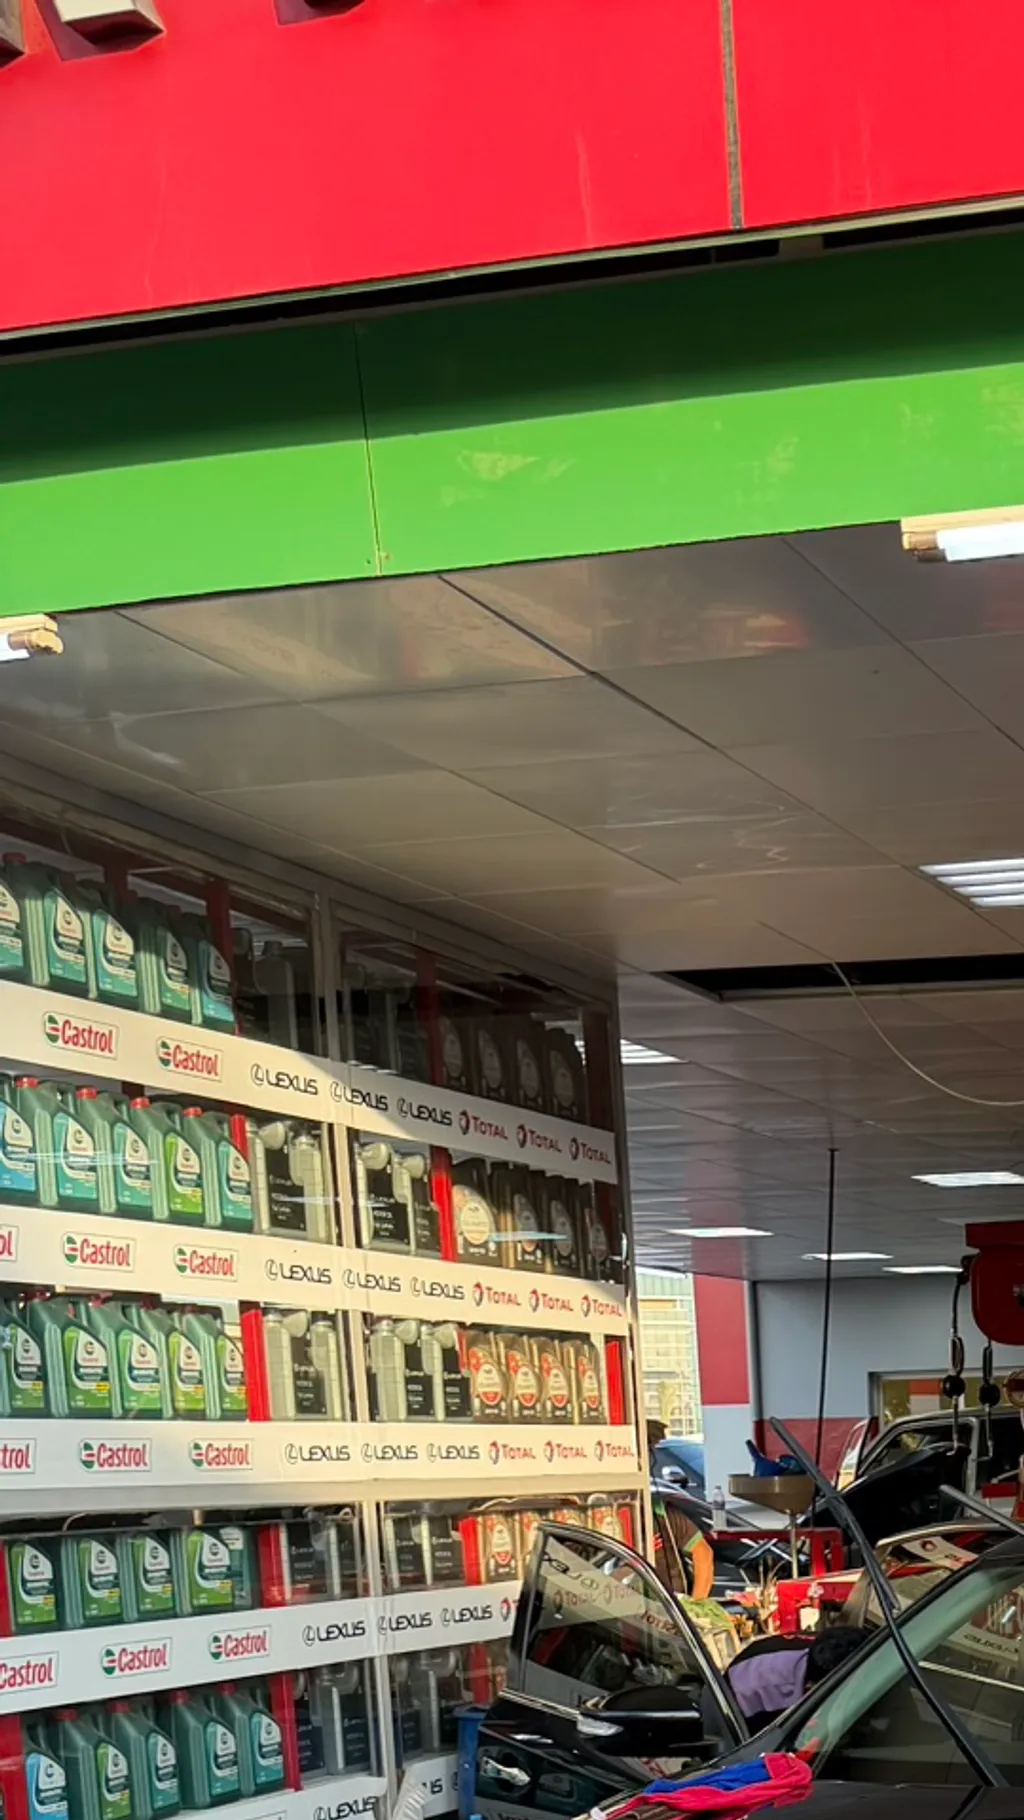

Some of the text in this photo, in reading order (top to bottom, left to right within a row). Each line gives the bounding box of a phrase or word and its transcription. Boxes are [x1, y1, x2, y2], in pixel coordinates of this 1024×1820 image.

[61, 1018, 612, 1165] Castrol Castrol LEXUS LEXUS LEXUS TOTAL TOTAL TOTAL
[79, 1238, 623, 1317] Castrol Castrol LEXUS LEXUS LEXUS TOTAL TOTAL TOTAL
[0, 1443, 635, 1469] trol Castrol Castrol LEXUS LEXUS LEXUS TOTAL TOTAL TOTAL
[0, 1604, 493, 1690] Castrol Castrol Castrol LEXUS LEXUS LEXUS
